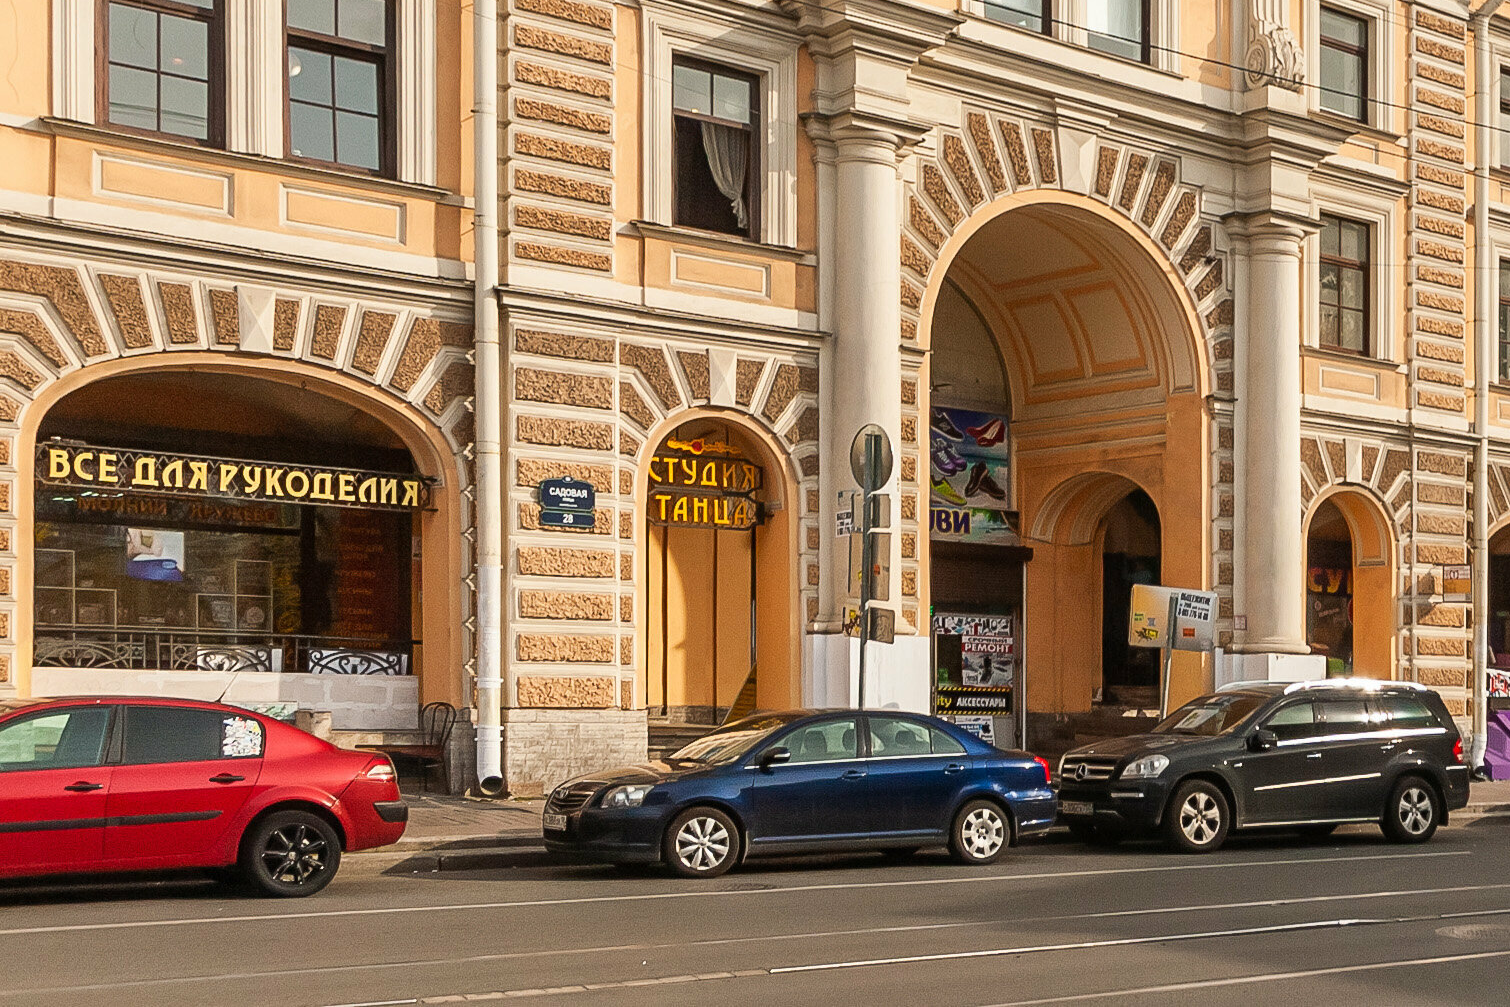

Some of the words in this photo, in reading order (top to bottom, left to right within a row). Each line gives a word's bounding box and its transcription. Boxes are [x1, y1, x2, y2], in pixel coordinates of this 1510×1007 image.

[49, 448, 118, 483] ВСЕ
[131, 458, 208, 490] ДЛЯ
[219, 463, 419, 506] РУКОДЕЛИЯ
[649, 456, 755, 489] СТУДИЯ
[549, 487, 588, 499] САДОВАЯ
[655, 495, 748, 525] ТАНЦА
[964, 643, 1010, 653] РЕМОНТ
[956, 697, 1006, 708] АКСЕССУАРЫ
